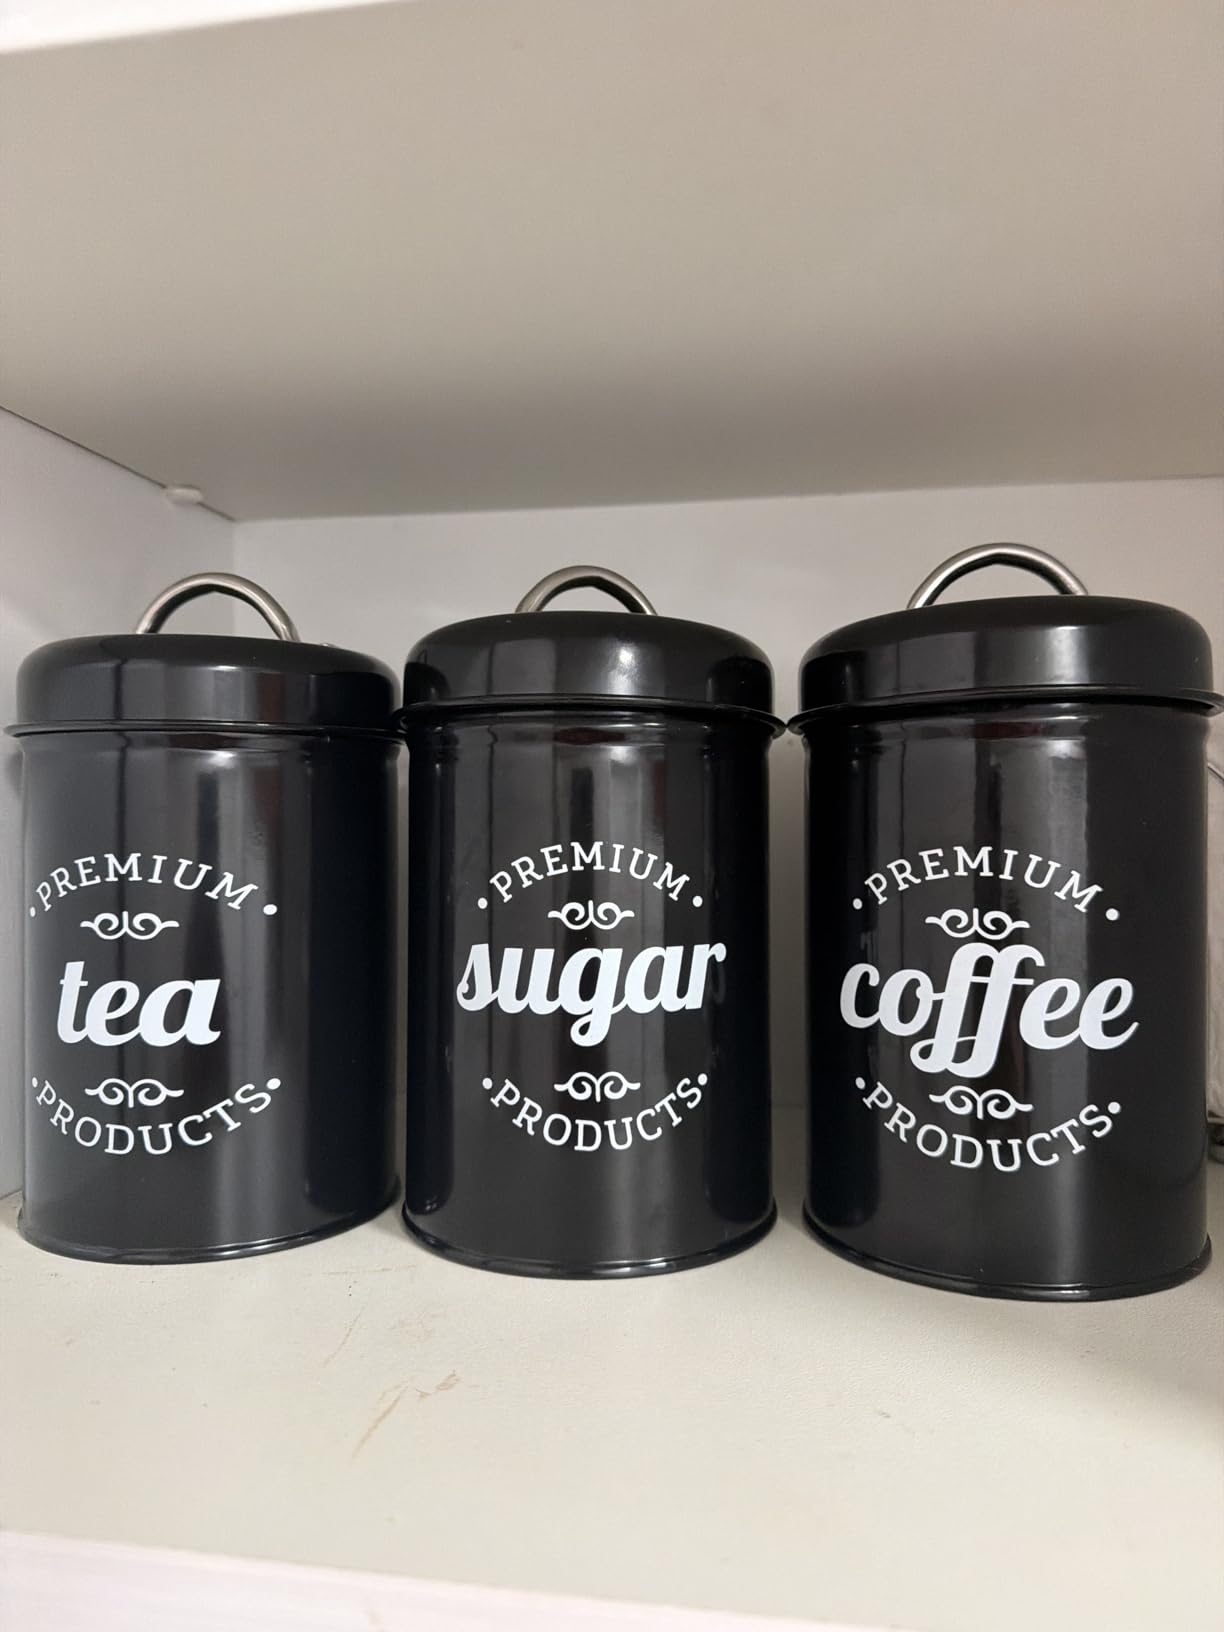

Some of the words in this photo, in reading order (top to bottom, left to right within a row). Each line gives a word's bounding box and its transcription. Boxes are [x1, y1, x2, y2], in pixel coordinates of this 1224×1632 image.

[35, 852, 260, 912] PREMIUM
[489, 840, 690, 903] PREMIUM
[864, 846, 1103, 913] PREMIUM
[56, 960, 221, 1047] tea
[456, 942, 727, 1047] sugar
[840, 942, 1139, 1078] coffee
[35, 1080, 272, 1155] PRODUCTS
[490, 1078, 702, 1152] PRODUCTS
[861, 1081, 1113, 1172] PRODUCTS
